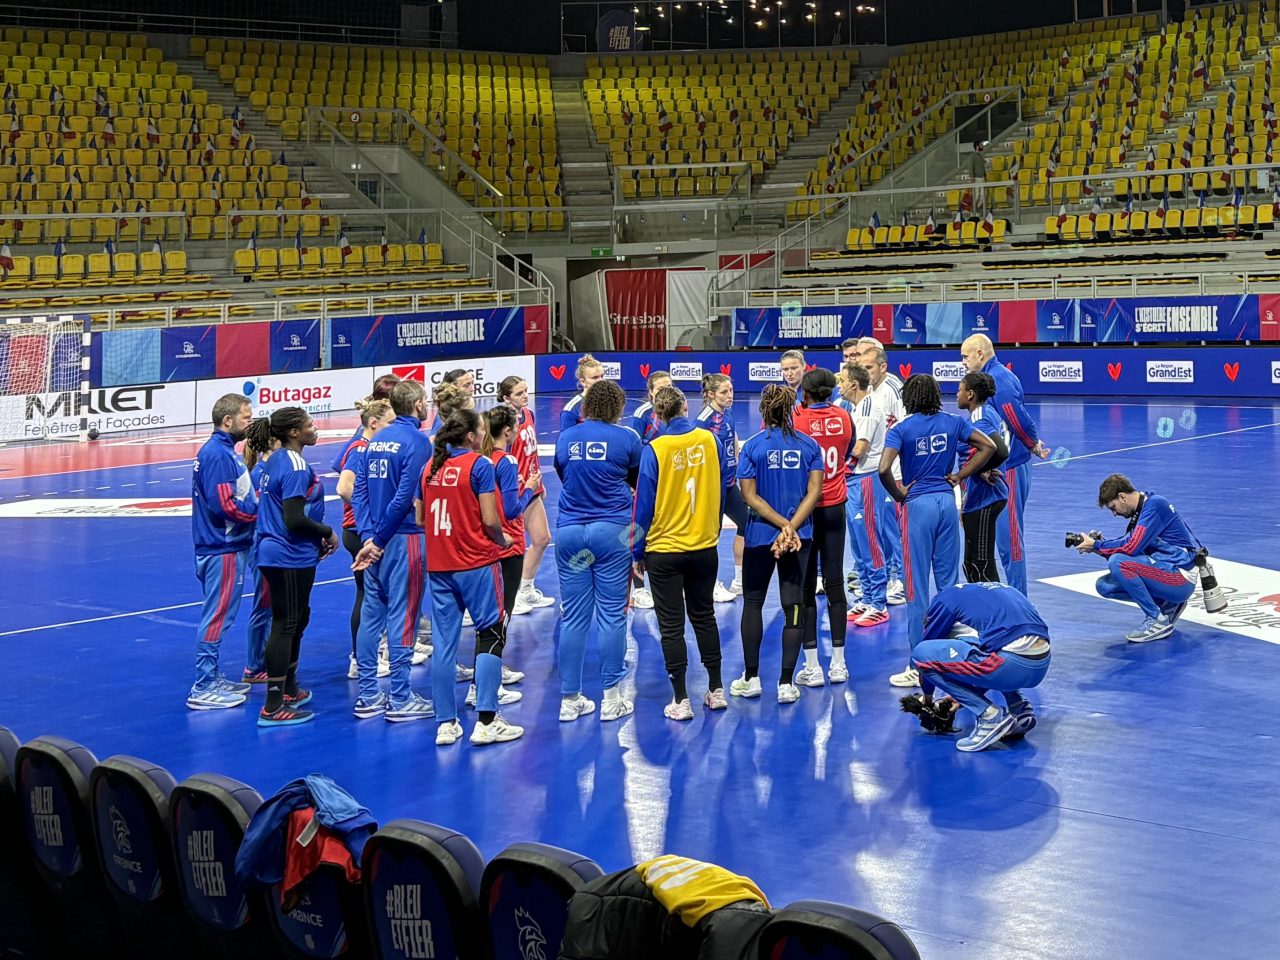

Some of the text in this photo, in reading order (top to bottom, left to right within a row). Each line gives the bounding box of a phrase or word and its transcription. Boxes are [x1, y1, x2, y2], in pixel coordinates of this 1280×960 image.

[431, 318, 485, 344] ENSEMBLE
[802, 314, 843, 338] ENSEMBLE
[1167, 305, 1219, 332] ENSEMBLE
[259, 385, 332, 405] Butagaz
[88, 418, 103, 430] et
[106, 414, 165, 431] Façades
[686, 476, 695, 514] 1
[430, 498, 452, 537] 14
[385, 883, 422, 919] #BLEU
